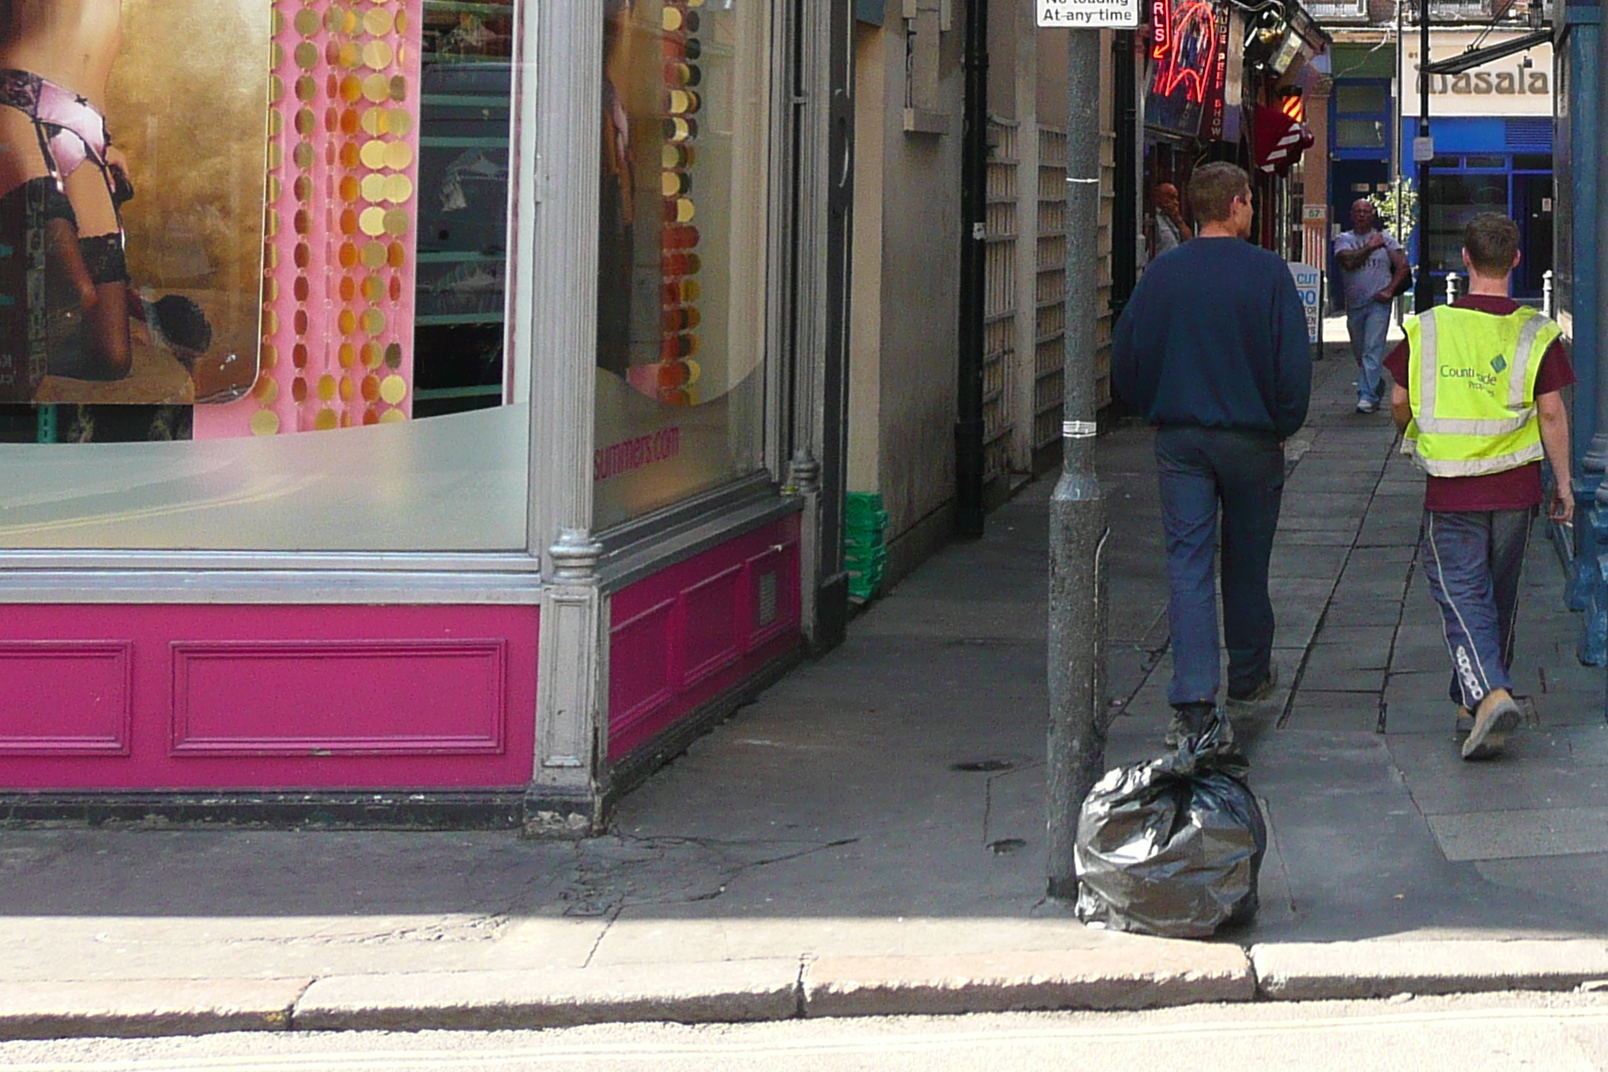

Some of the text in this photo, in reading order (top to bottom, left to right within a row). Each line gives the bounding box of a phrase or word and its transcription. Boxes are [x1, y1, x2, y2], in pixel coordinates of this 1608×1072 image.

[1043, 8, 1132, 23] At any time
